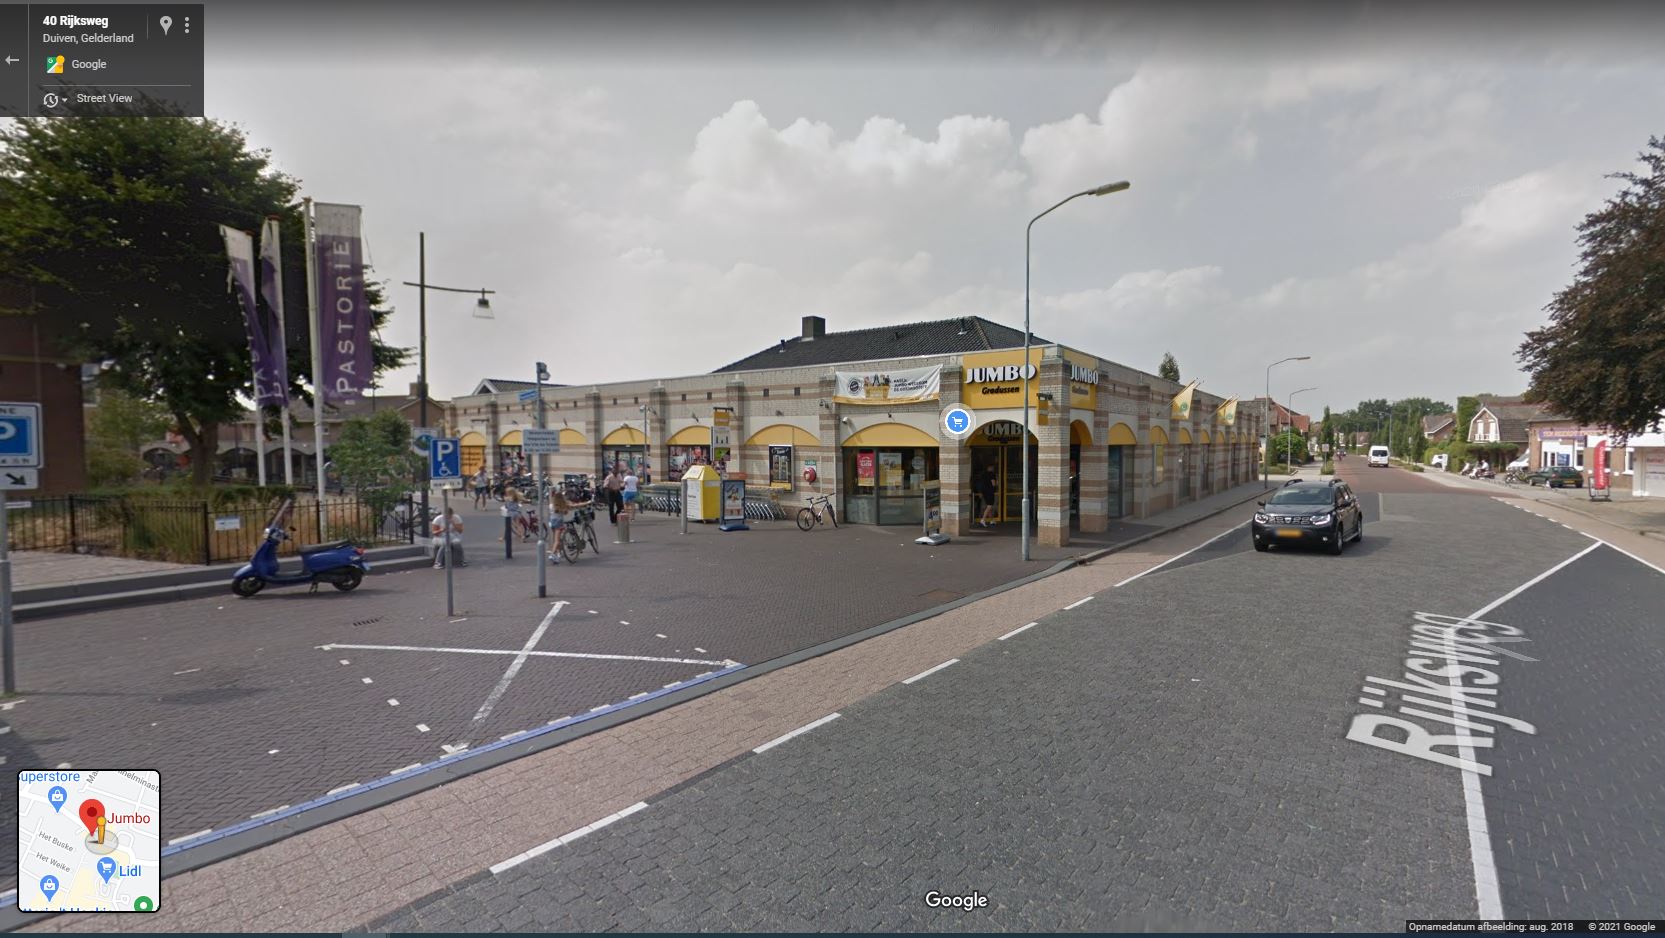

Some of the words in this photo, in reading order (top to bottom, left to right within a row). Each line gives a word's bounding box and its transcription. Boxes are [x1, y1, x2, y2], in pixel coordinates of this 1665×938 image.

[333, 240, 359, 394] PASTORIE
[964, 364, 1037, 384] JUMBO
[1071, 364, 1099, 385] JUMBO
[437, 441, 453, 462] P
